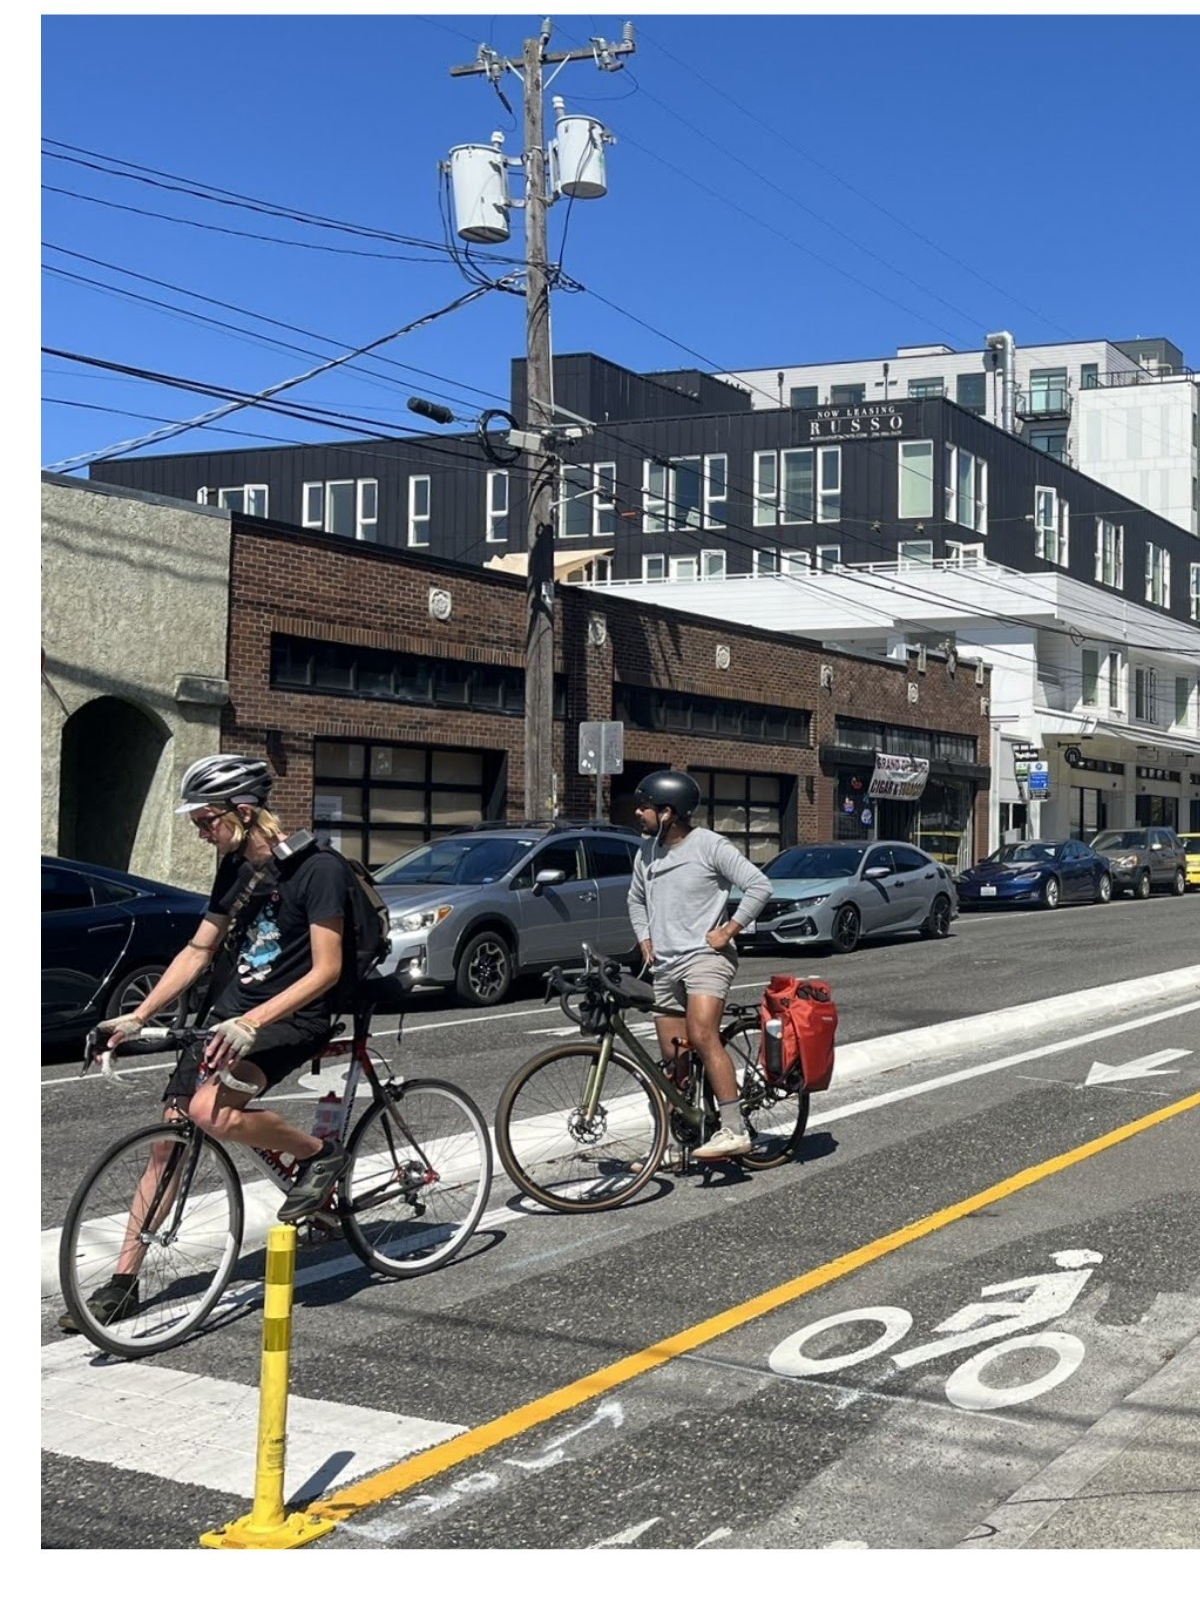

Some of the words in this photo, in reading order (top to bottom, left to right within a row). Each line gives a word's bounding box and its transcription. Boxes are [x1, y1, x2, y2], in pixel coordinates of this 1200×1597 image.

[818, 409, 839, 419] NOW
[847, 405, 895, 417] LEASING
[810, 416, 902, 435] RUSSO
[877, 757, 900, 771] GRAND
[870, 779, 894, 795] CIGAR
